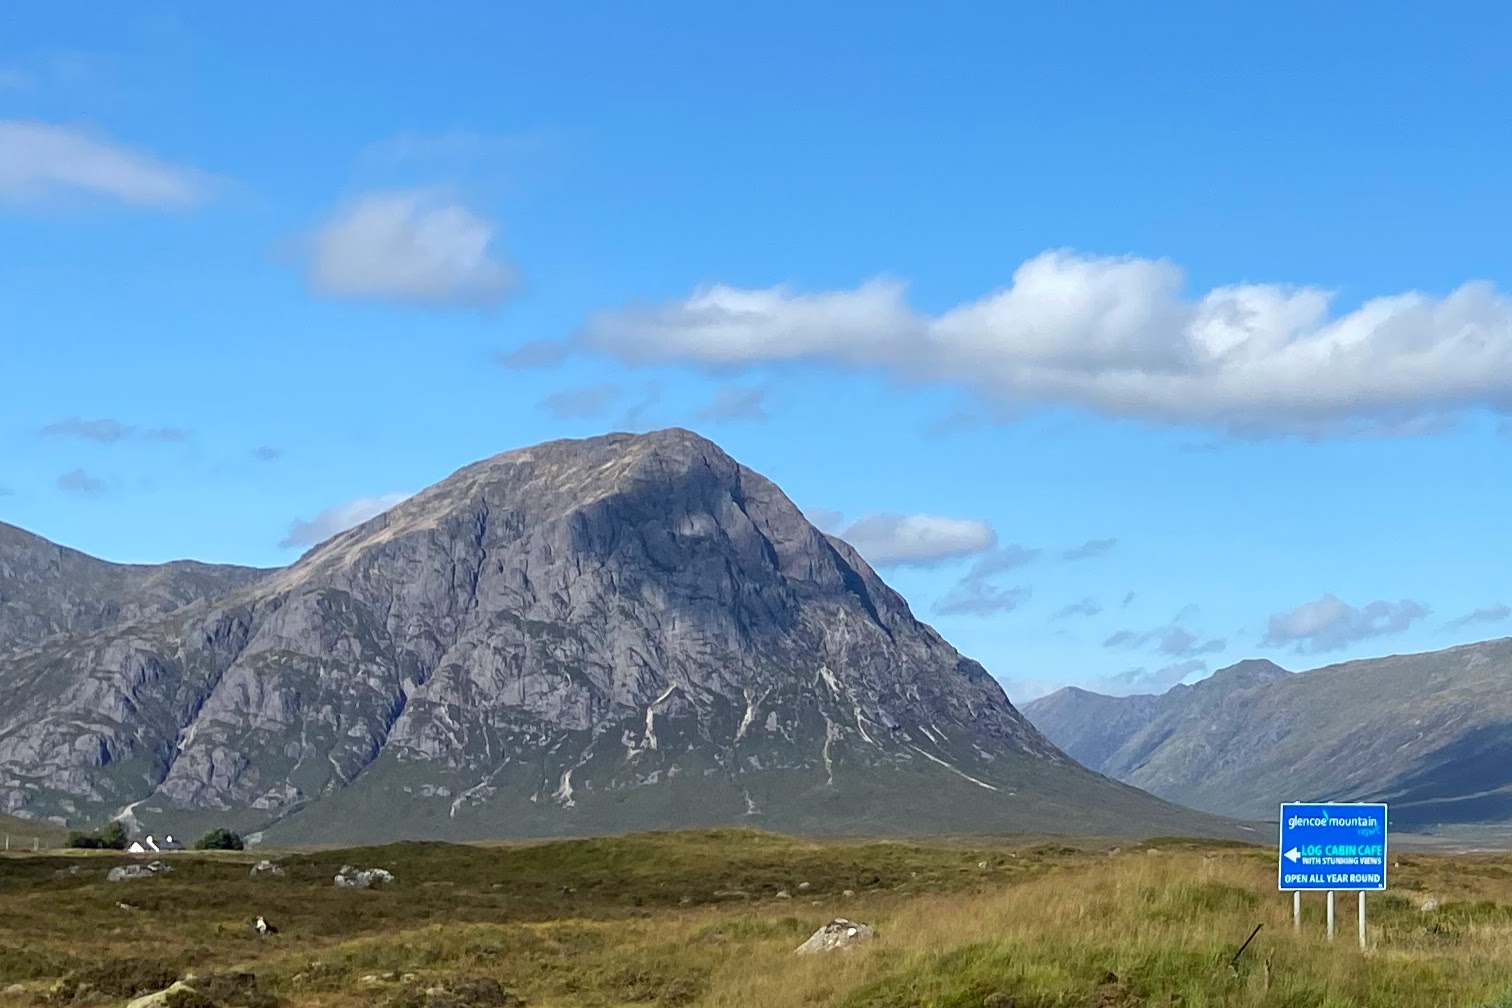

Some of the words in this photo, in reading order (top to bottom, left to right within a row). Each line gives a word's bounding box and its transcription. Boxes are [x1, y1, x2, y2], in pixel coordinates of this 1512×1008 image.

[1288, 815, 1327, 829] glencoe
[1329, 816, 1377, 826] mountain
[1302, 845, 1322, 856] LOG
[1325, 845, 1356, 856] CABIN
[1358, 845, 1382, 856] CAFE
[1302, 857, 1321, 865] WITH
[1360, 857, 1382, 865] VIEWS
[1285, 874, 1308, 883] OPEN
[1309, 874, 1325, 883] ALL
[1327, 874, 1349, 883] YEAR
[1350, 874, 1380, 883] ROUND
